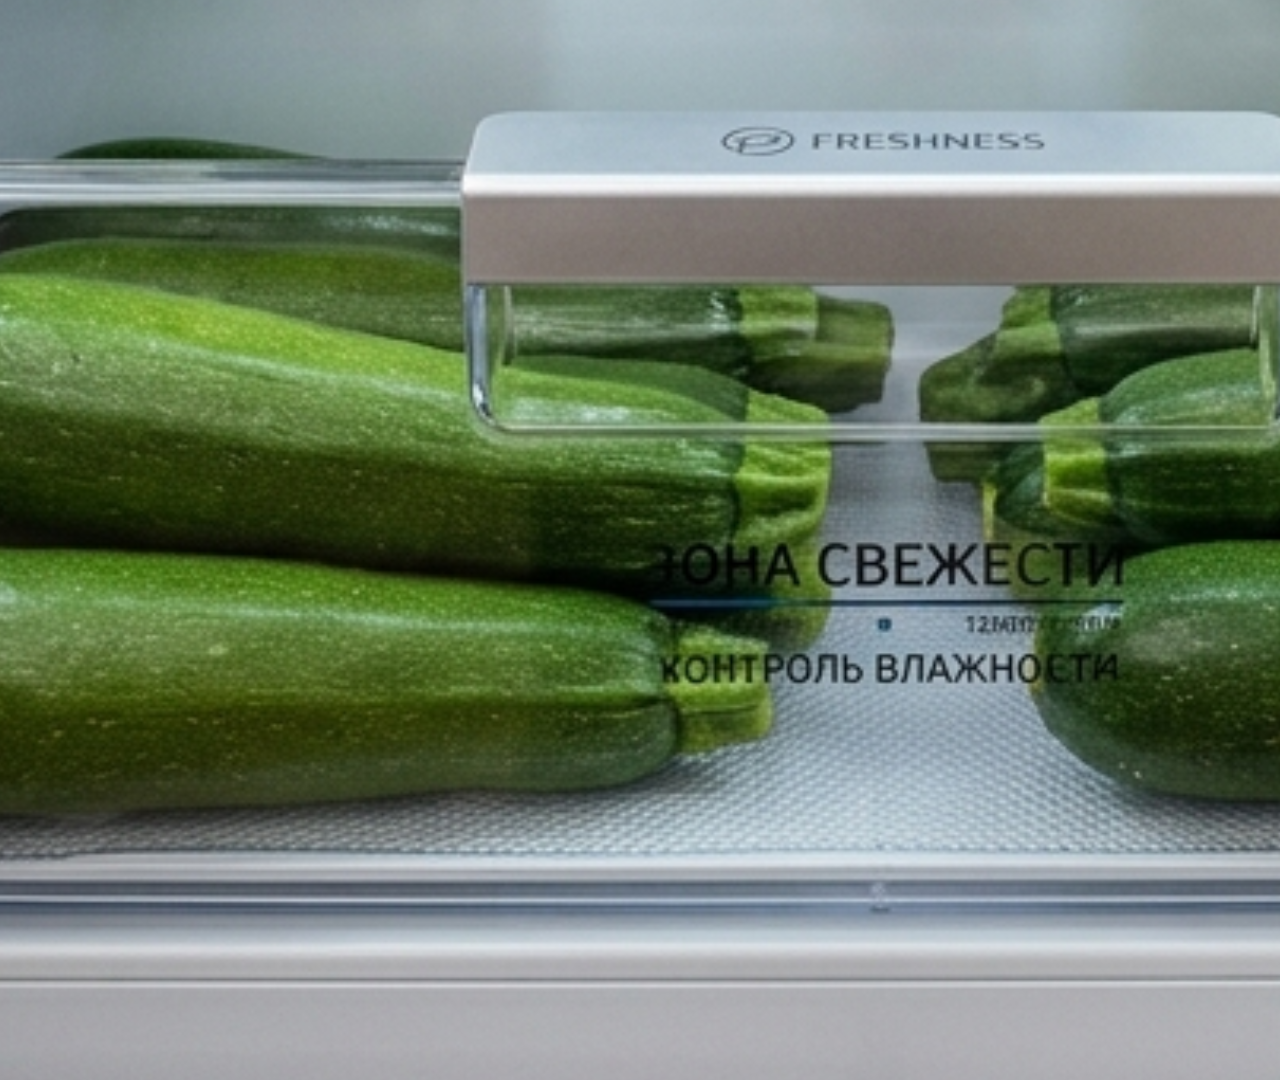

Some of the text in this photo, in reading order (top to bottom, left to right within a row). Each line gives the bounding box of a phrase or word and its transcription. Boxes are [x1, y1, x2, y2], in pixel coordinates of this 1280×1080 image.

[811, 131, 1046, 150] FRESHNESS
[819, 542, 1124, 587] СВЕЖЕСТИ
[661, 653, 1119, 683] КОНТРОЛЬ ВЛАЖНОСТИ
